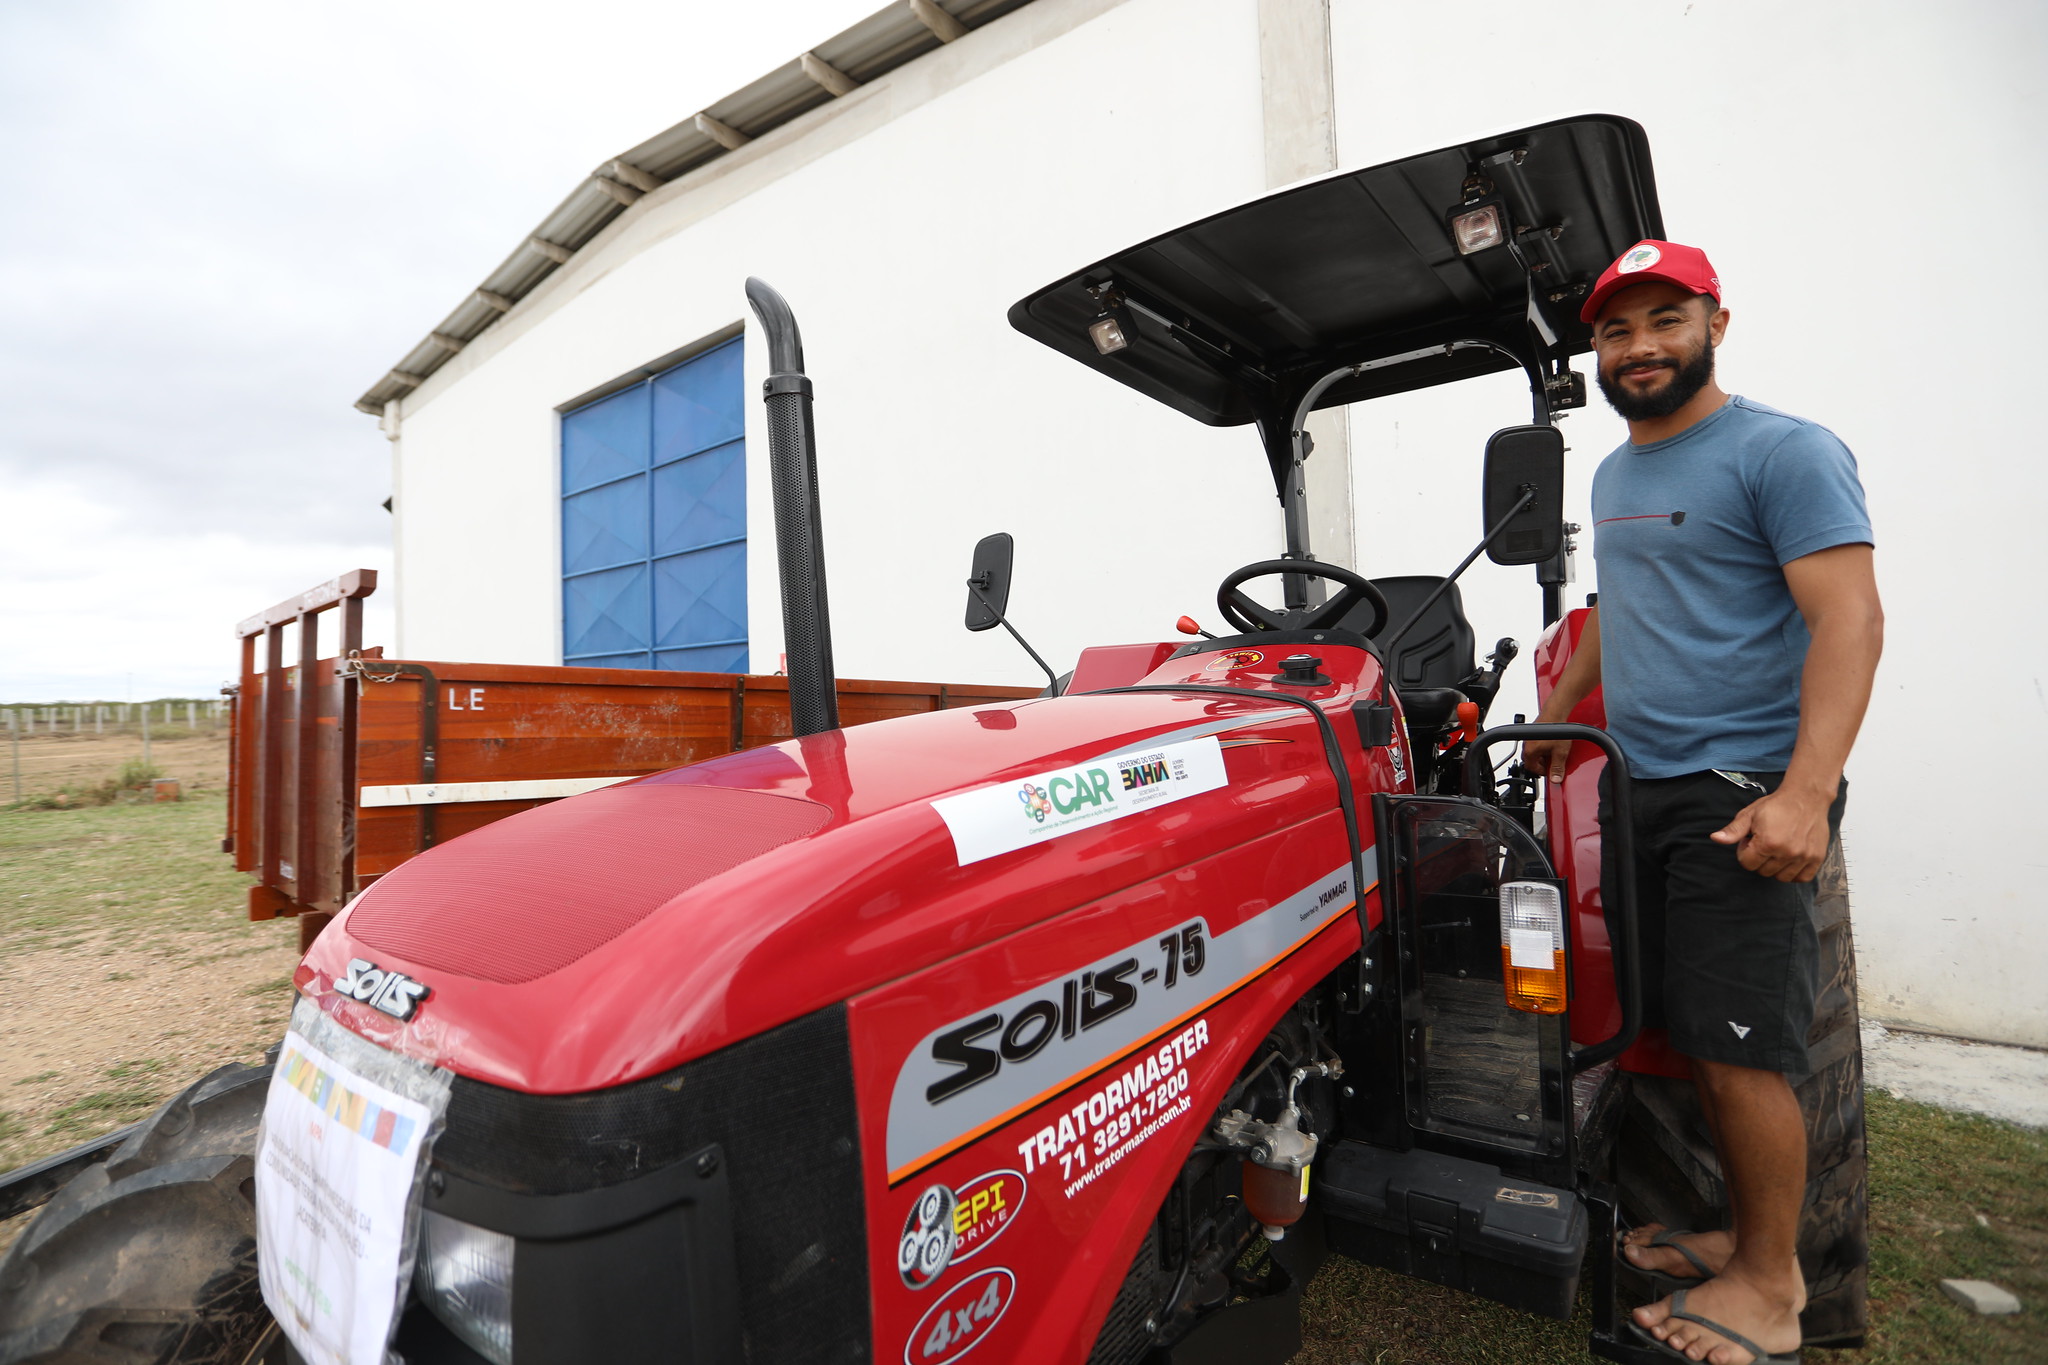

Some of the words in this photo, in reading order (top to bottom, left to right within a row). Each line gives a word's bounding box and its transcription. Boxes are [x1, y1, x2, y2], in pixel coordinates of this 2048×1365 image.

[1117, 758, 1141, 769] GOVERNO
[1148, 753, 1165, 762] ESTADO
[1049, 768, 1114, 815] CAR
[1319, 880, 1347, 907] YANMAR
[1018, 1019, 1209, 1174] TRATORMASTER
[1060, 1143, 1086, 1181] 71
[1094, 1068, 1188, 1157] 3291-7200
[1064, 1094, 1192, 1199] www.tratormaster.com.br
[952, 1179, 1006, 1235] EPI
[955, 1208, 1008, 1250] DRIVE
[922, 1276, 1001, 1358] 4x4
